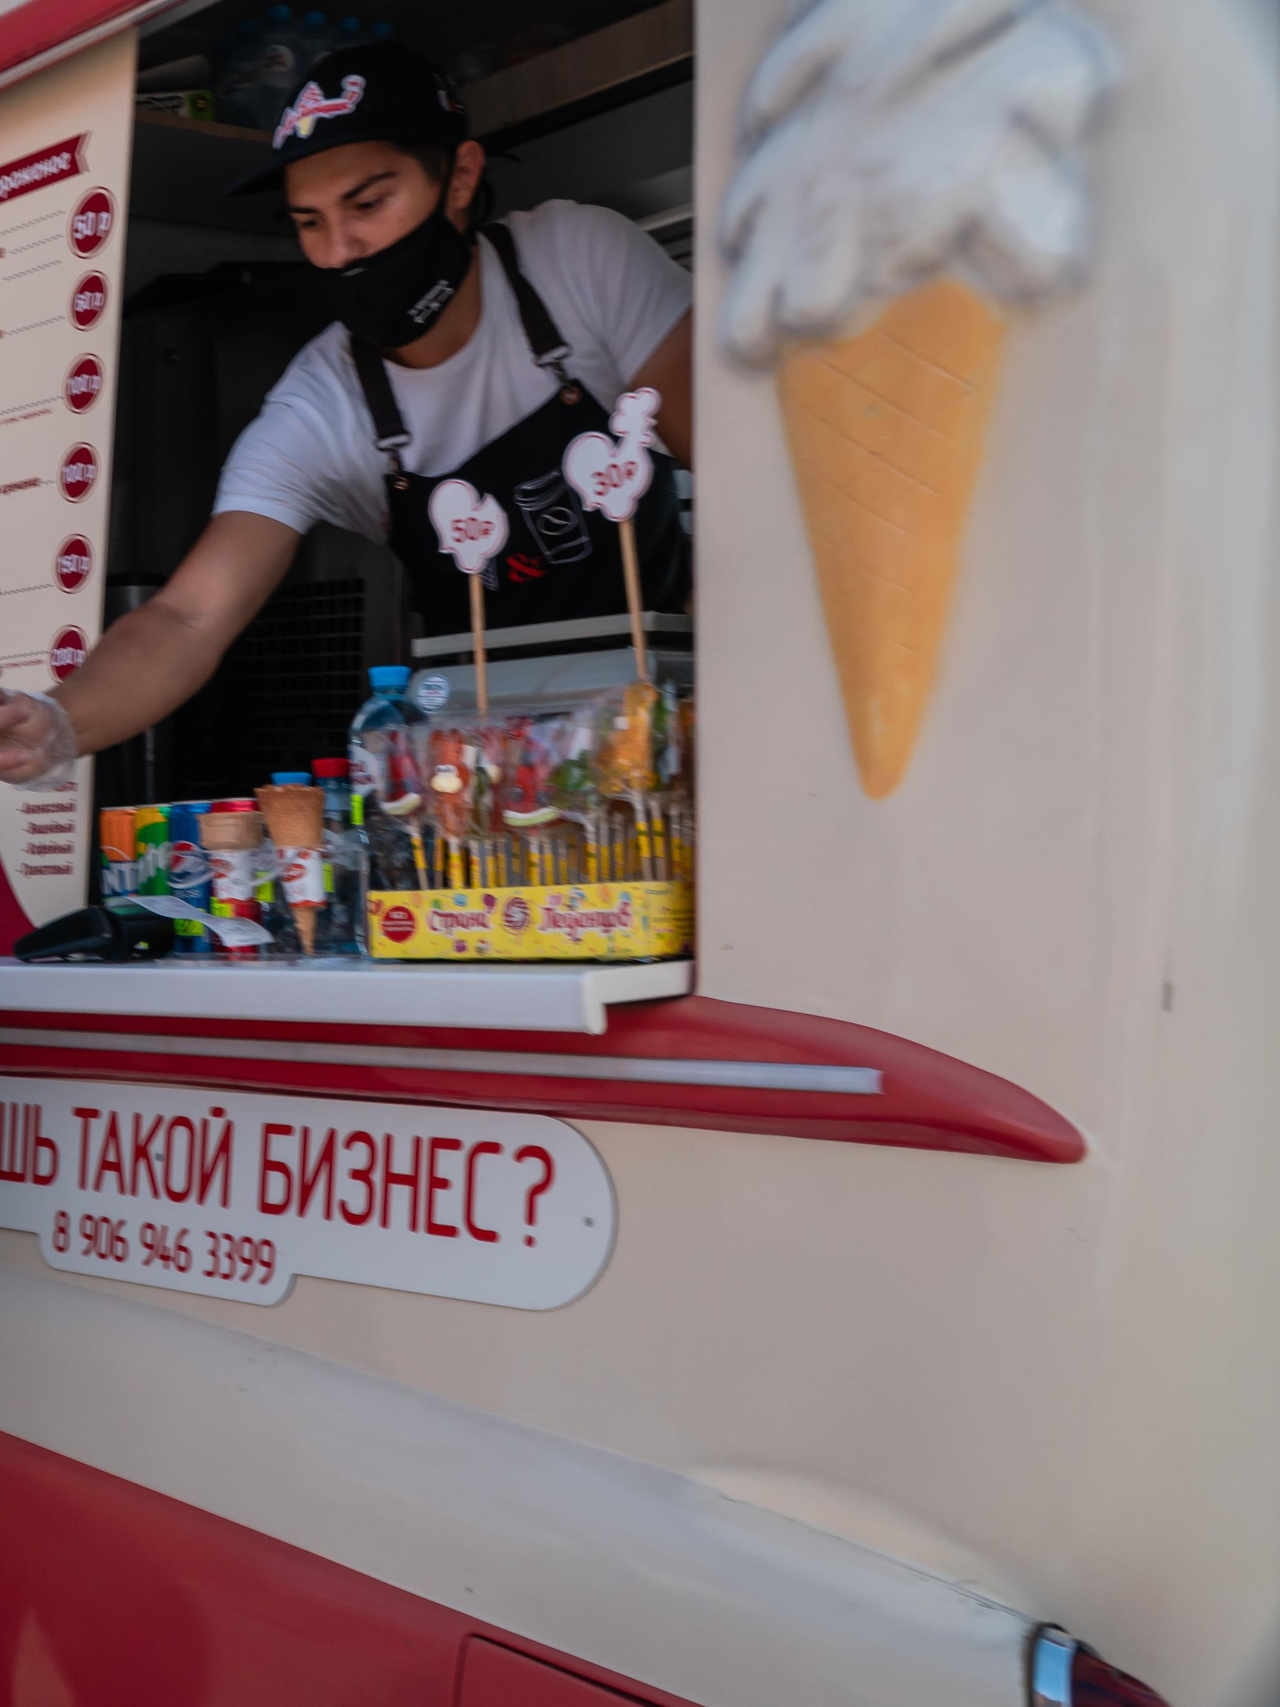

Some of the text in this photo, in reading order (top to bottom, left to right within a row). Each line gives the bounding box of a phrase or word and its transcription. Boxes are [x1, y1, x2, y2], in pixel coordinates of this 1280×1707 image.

[72, 1105, 234, 1209] ТАКОЙ
[257, 1122, 557, 1248] БИЗНЕС?
[51, 1210, 277, 1286] 8 906 946 3399
